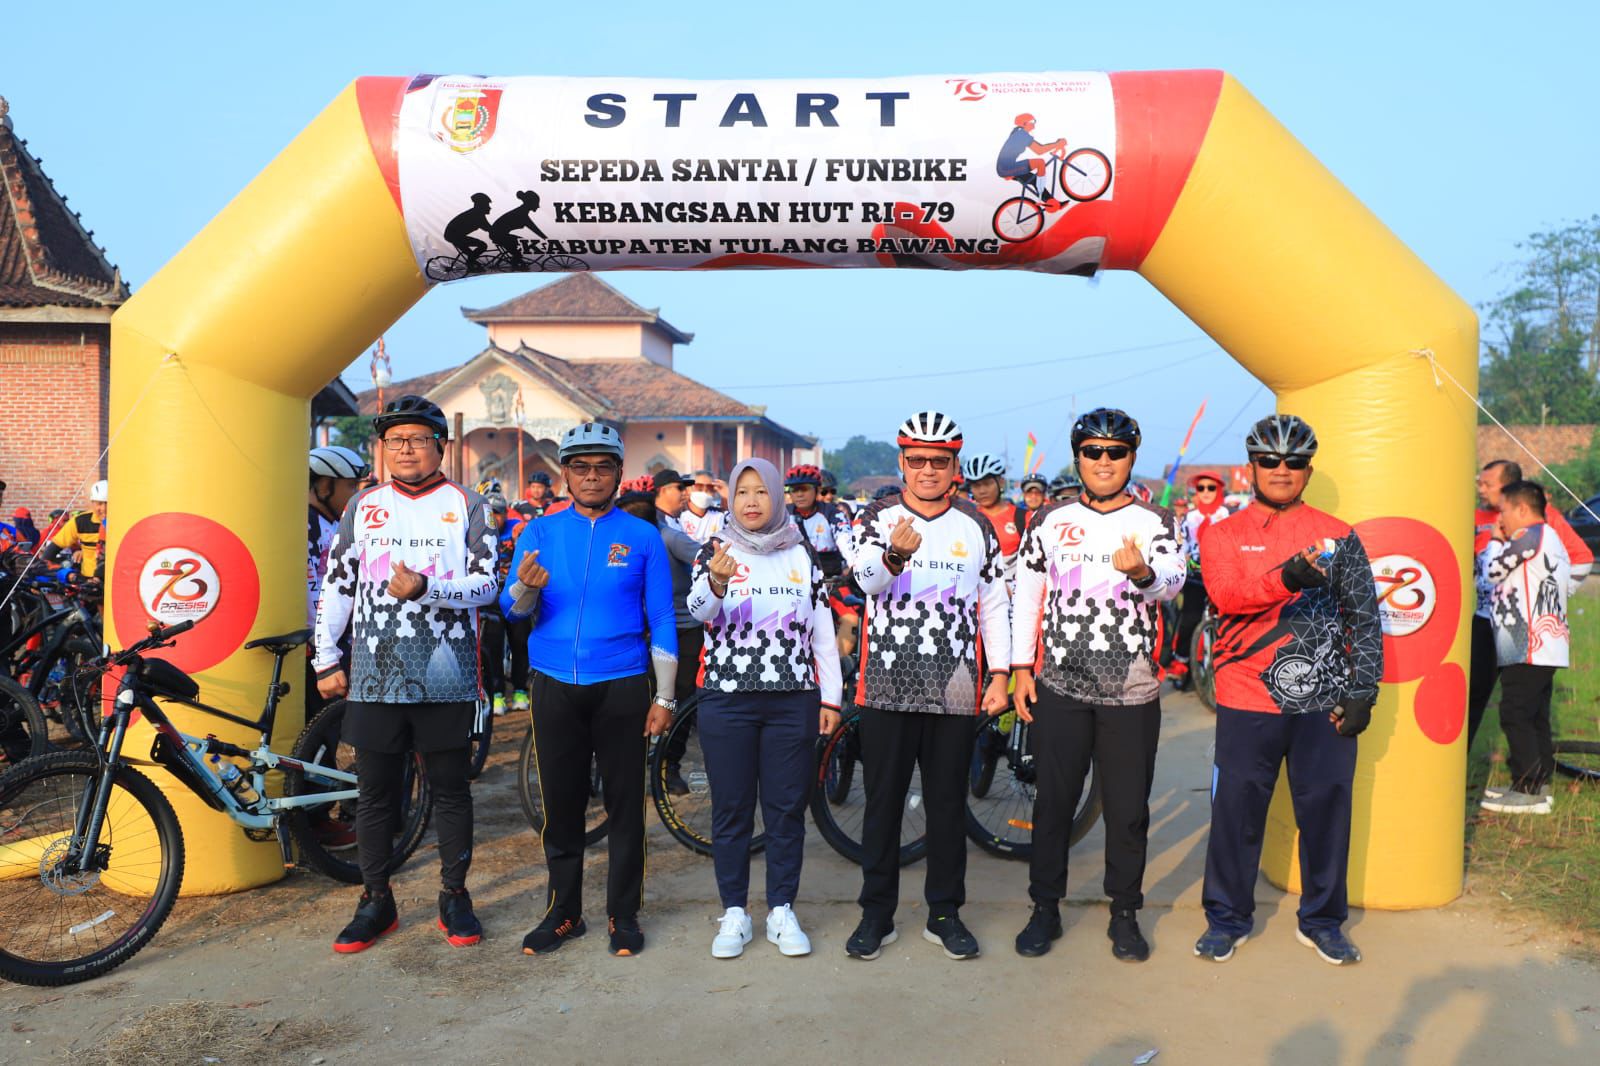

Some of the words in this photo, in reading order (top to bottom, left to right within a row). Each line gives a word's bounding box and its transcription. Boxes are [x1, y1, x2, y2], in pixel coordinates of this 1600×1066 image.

[584, 92, 910, 128] START
[540, 158, 664, 182] SEPEDA
[671, 158, 798, 182] SANTAI
[825, 158, 967, 182] FUNBIKE
[553, 201, 780, 223] KEBANGSAAN
[788, 202, 854, 223] HUT
[861, 202, 896, 223] RI
[921, 201, 956, 224] 79
[520, 238, 713, 255] KABUPATEN
[719, 238, 853, 254] TULANG
[856, 238, 1000, 254] BAWANG
[370, 538, 402, 547] FUN
[409, 538, 447, 547] BIKE
[929, 559, 965, 572] BIKE
[1061, 553, 1094, 562] FUN
[471, 579, 497, 599] FUN
[730, 586, 762, 598] FUN
[769, 586, 804, 597] BIKE
[160, 601, 208, 610] PRESISI
[63, 926, 147, 974] SCHWALBE
